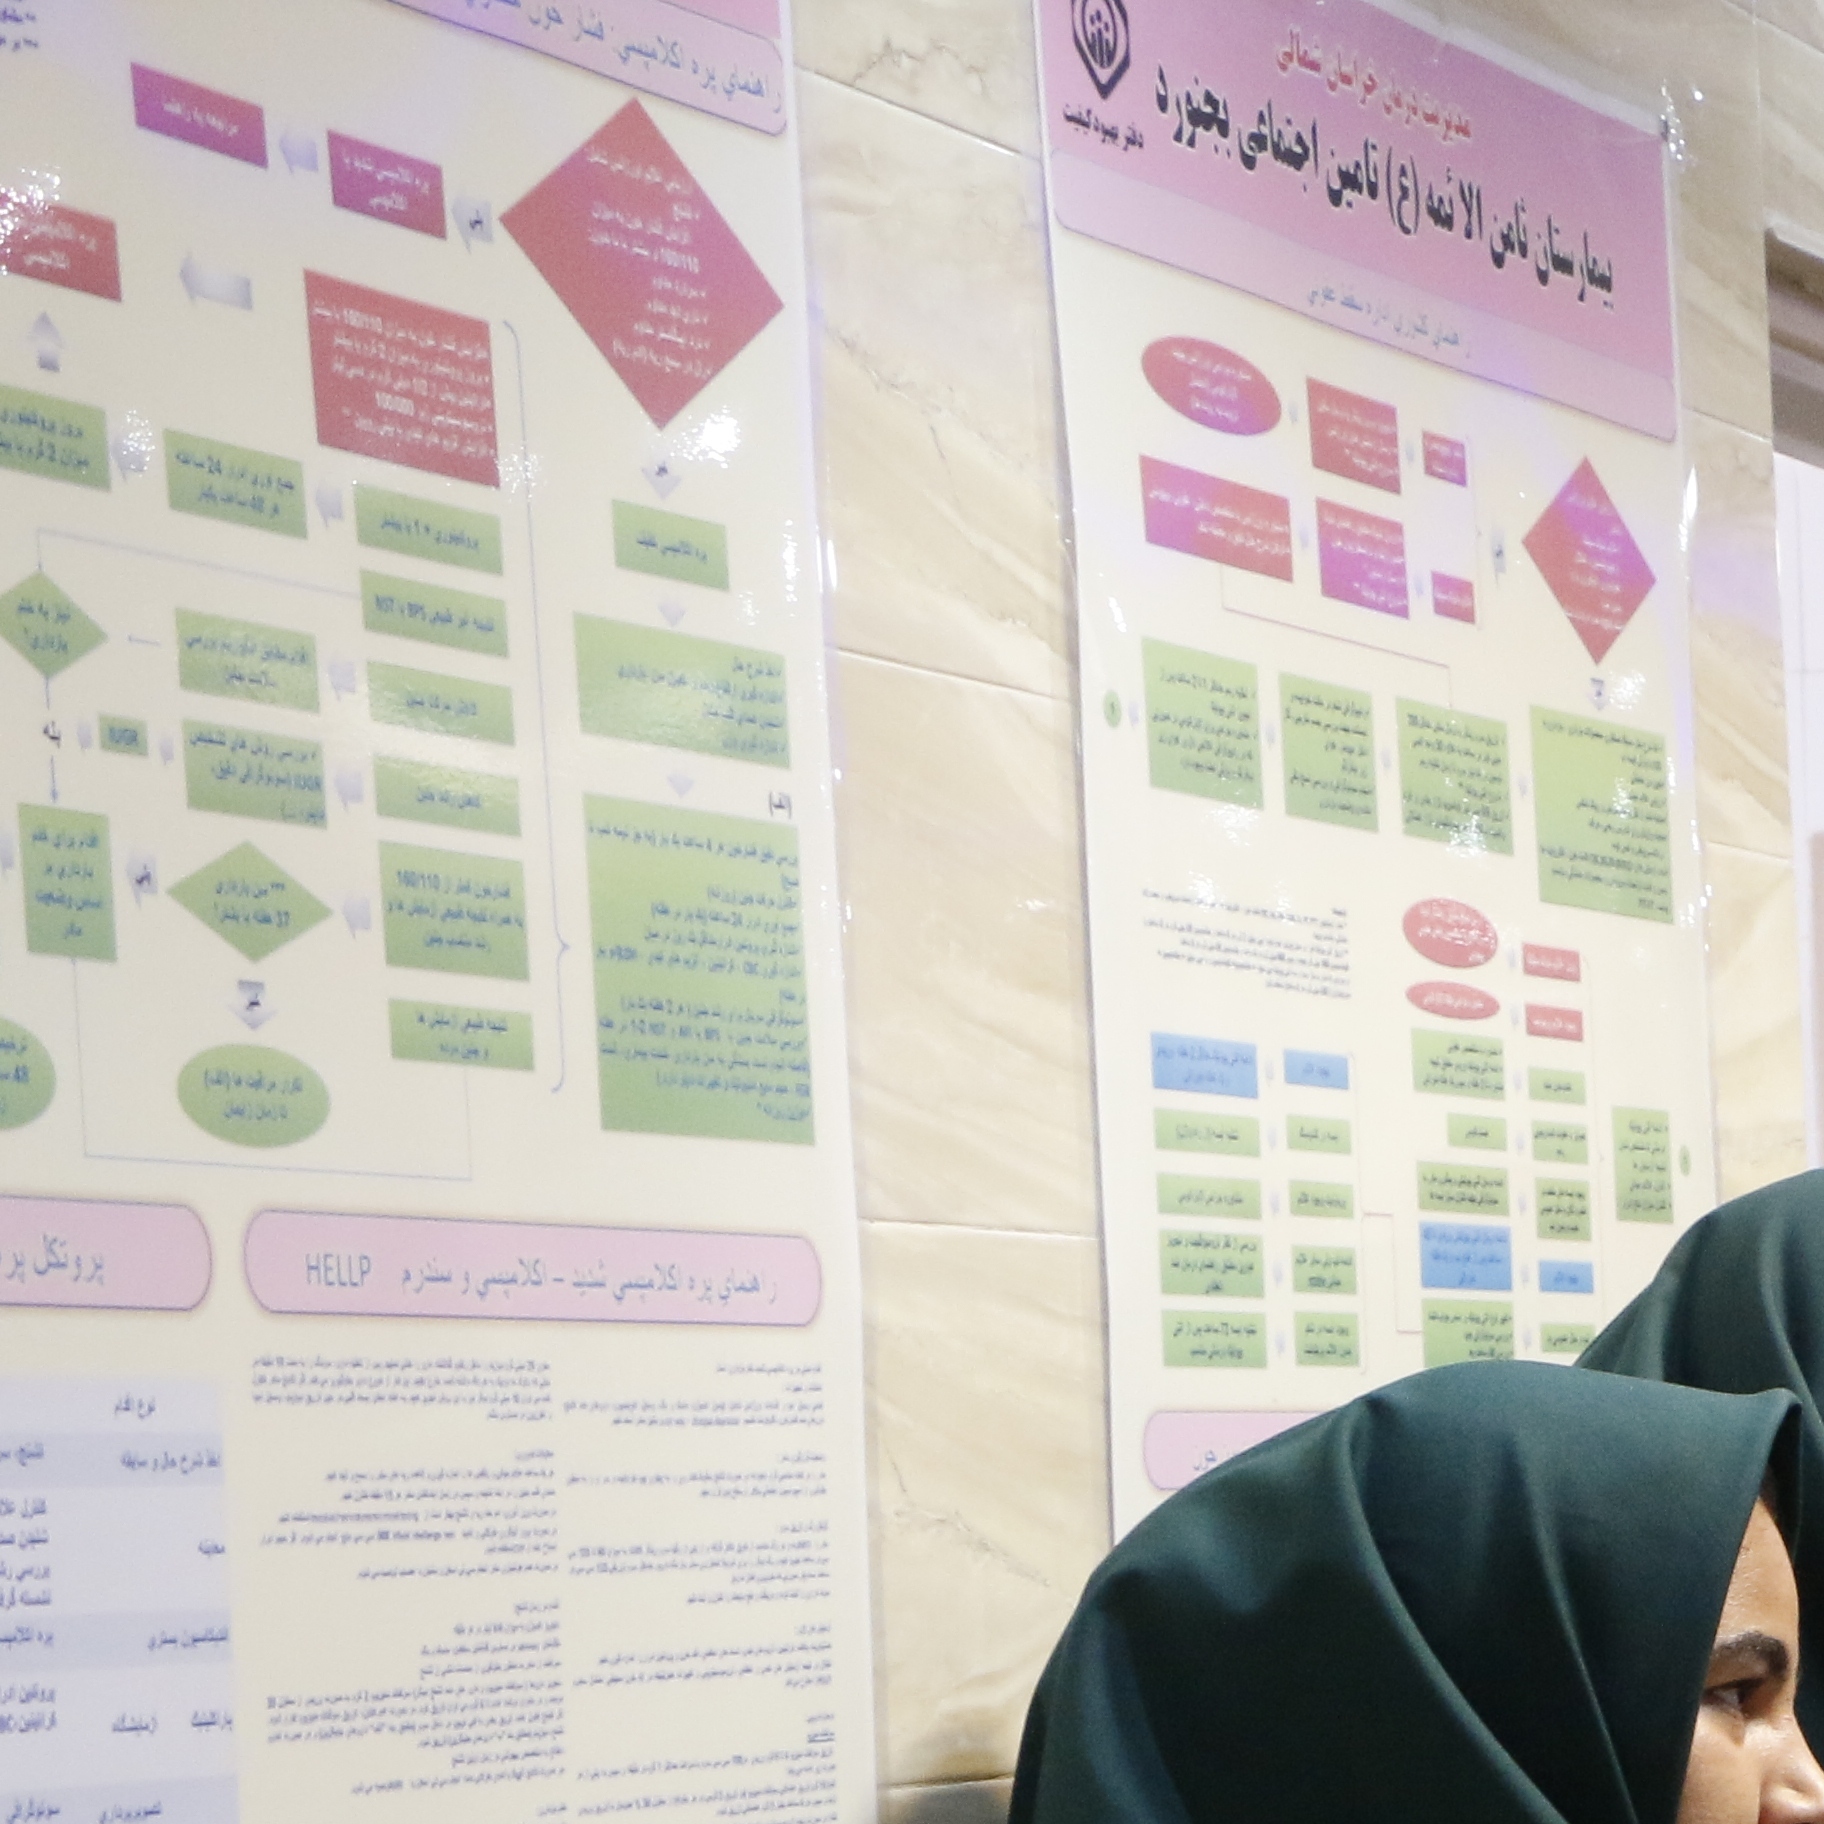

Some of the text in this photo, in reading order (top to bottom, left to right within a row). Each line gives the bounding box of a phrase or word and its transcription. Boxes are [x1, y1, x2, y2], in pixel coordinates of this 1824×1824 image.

[1155, 61, 1230, 159] بجنورد
[1237, 98, 1319, 192] اجتماعی
[1386, 146, 1420, 236] (ع)
[1489, 197, 1528, 269] ثامن
[1535, 213, 1615, 310] بیمارستان
[0, 1248, 25, 1284] پر
[305, 1253, 371, 1288] HELLP
